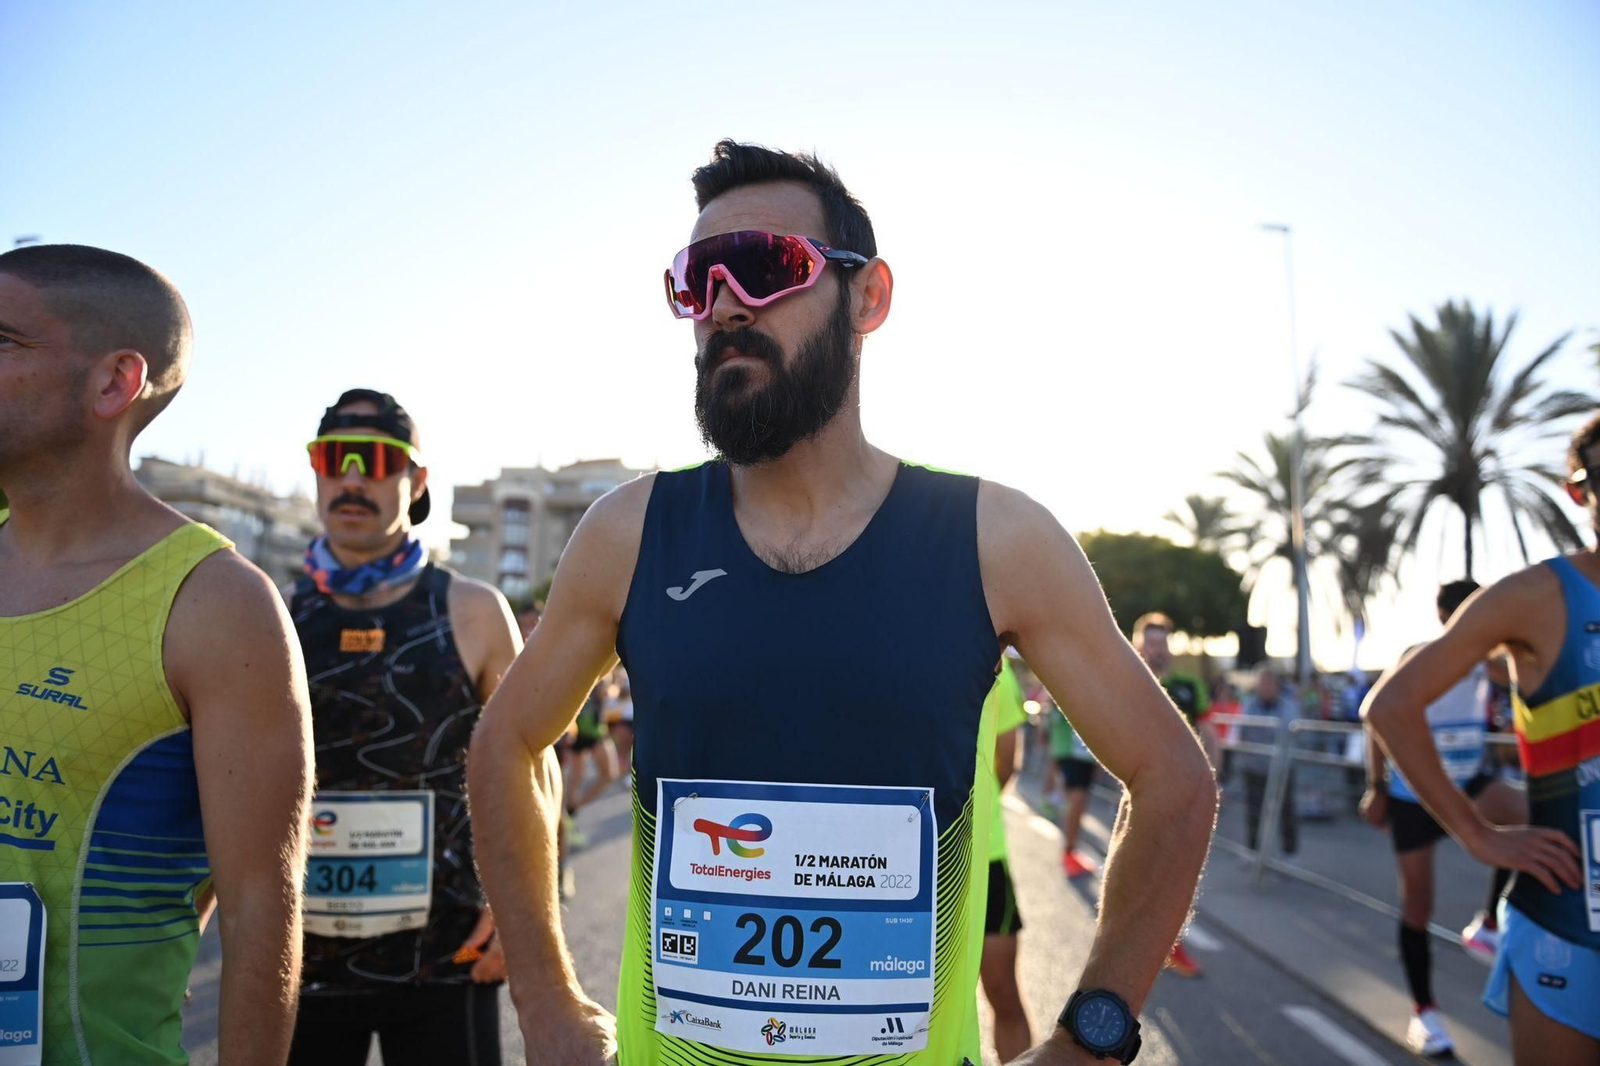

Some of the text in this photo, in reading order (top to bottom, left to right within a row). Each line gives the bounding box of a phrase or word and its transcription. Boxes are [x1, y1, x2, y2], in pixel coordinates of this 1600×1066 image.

[15, 683, 88, 711] SURAL
[794, 853, 888, 870] 1/2 MARATÓN
[316, 864, 378, 894] 304
[690, 863, 772, 882] TotalEnergies
[793, 871, 913, 890] DE MÁLAGA 2022
[732, 912, 843, 969] 202
[731, 980, 841, 1001] DANI REINA
[685, 1013, 722, 1029] CaixaBank
